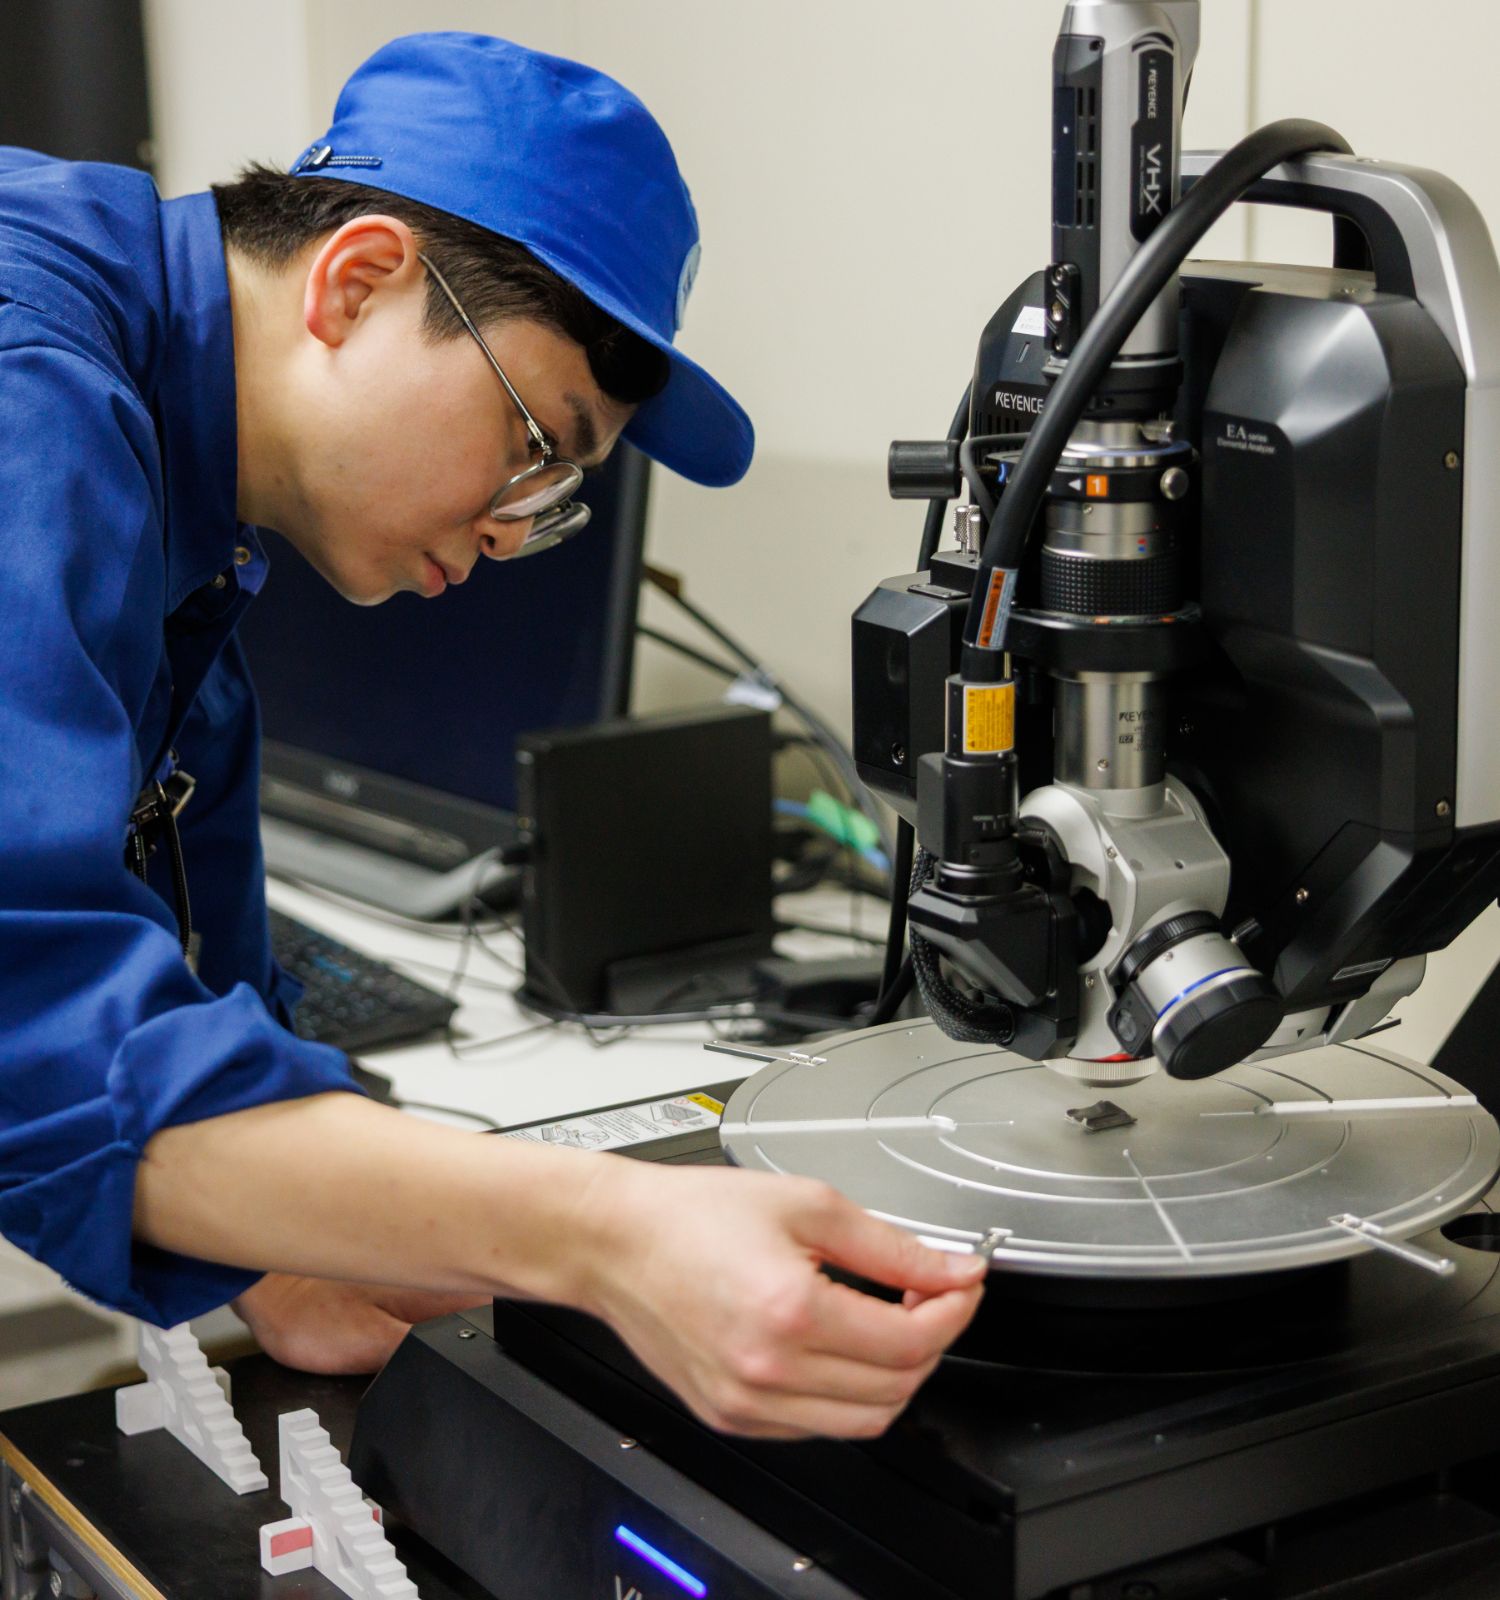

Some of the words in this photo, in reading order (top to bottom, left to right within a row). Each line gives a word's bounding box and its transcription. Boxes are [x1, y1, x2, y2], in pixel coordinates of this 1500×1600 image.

[1148, 69, 1158, 119] KEYENCE
[1143, 143, 1162, 216] VHX
[995, 391, 1044, 414] KEYENCE
[1226, 424, 1247, 440] EA
[1091, 479, 1100, 495] 1
